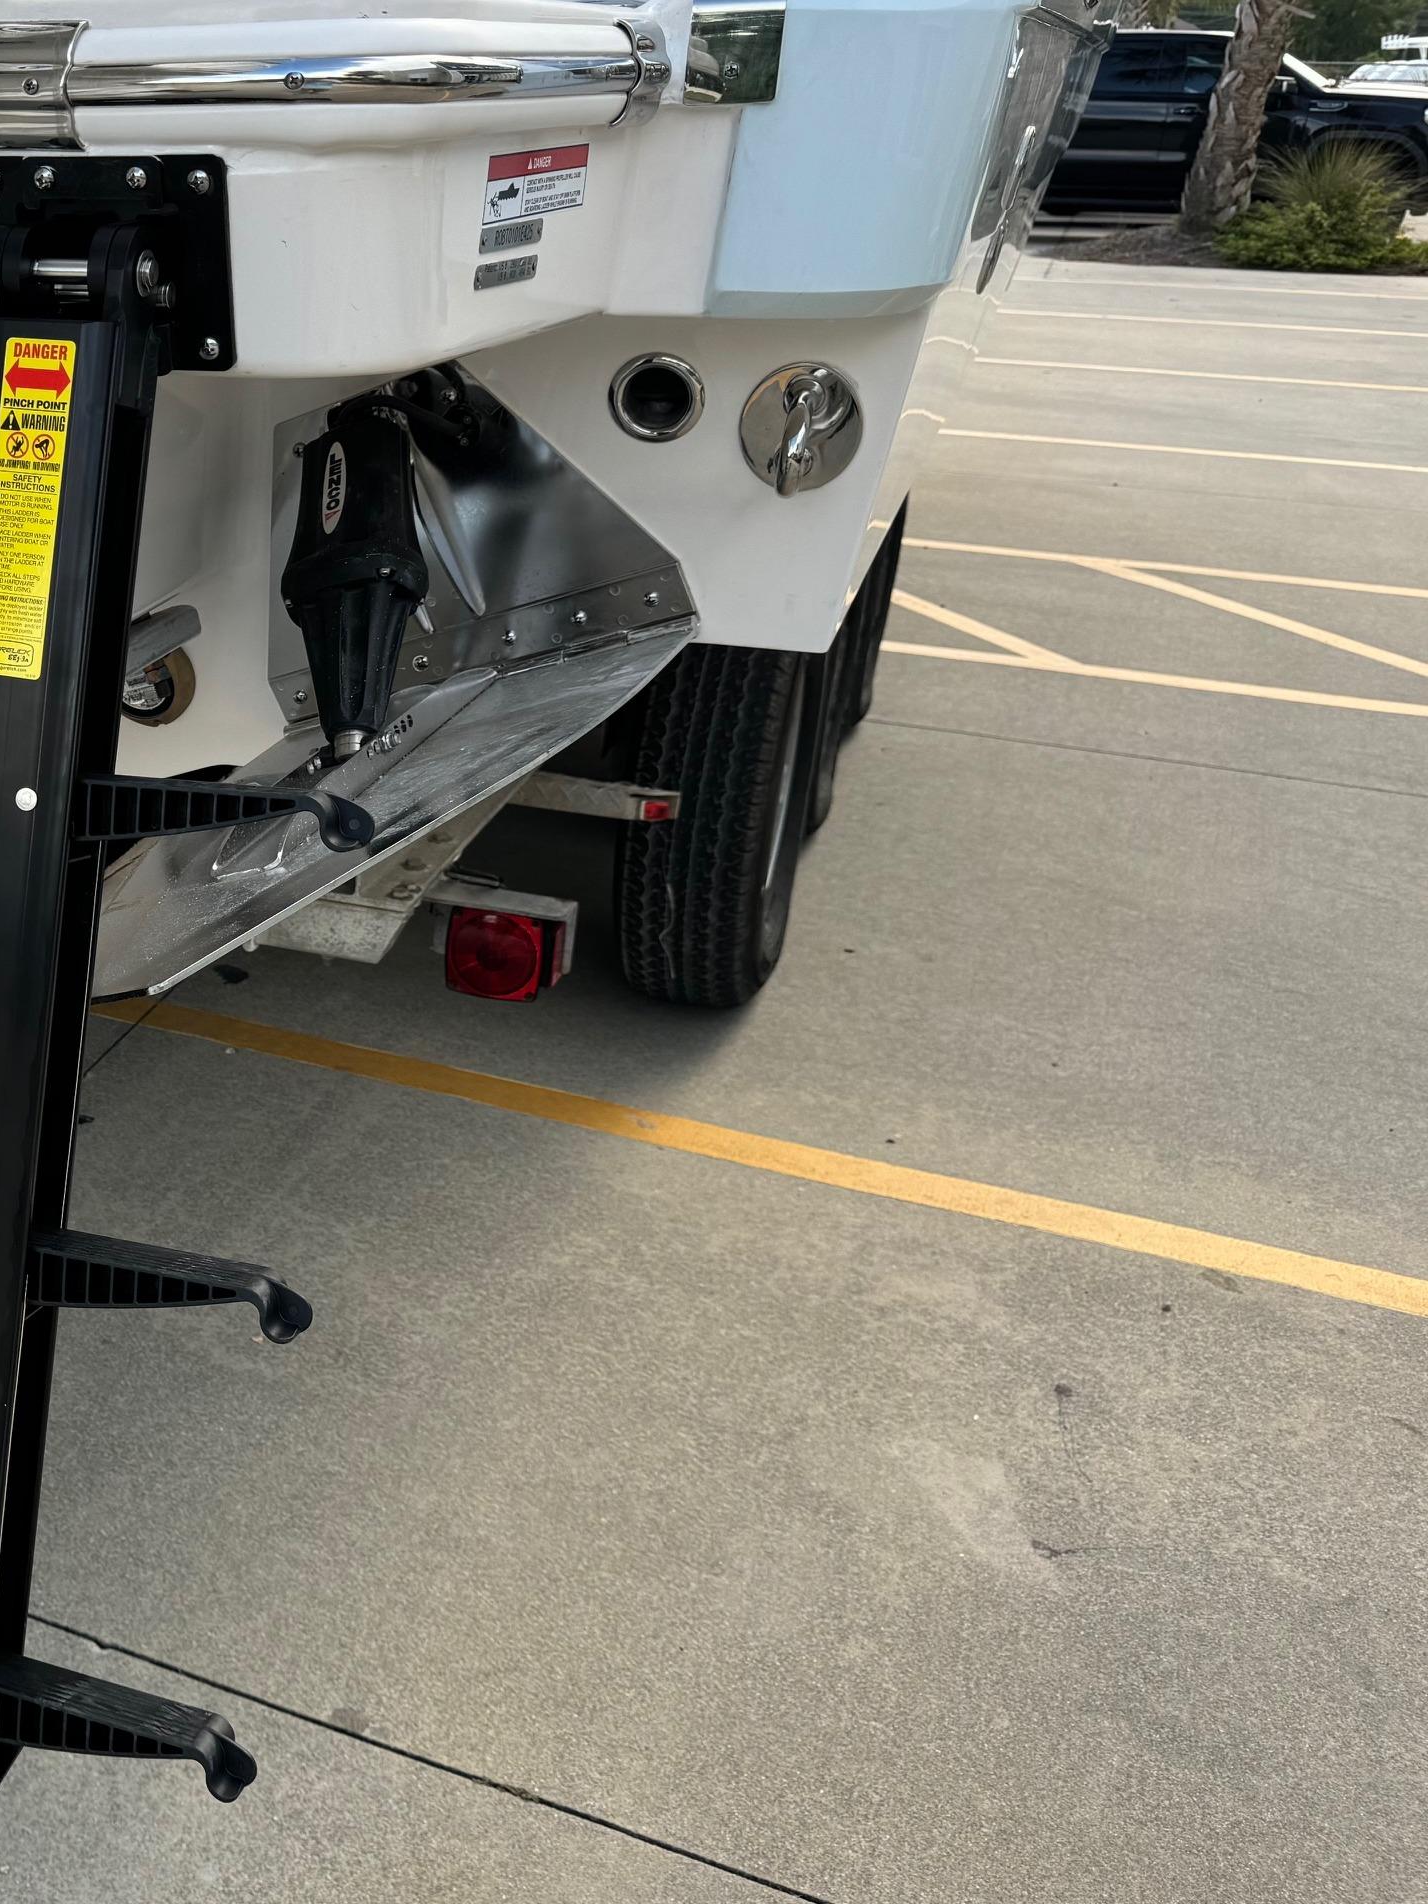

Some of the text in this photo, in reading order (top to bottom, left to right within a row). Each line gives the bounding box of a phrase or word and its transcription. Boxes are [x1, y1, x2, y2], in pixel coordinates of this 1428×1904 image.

[533, 156, 551, 168] DANGER
[13, 343, 68, 360] DANGER
[4, 398, 67, 410] PINCH POINT
[21, 414, 66, 431] WARNING
[33, 462, 40, 470] NO
[13, 474, 42, 483] SAFETY
[326, 453, 342, 511] LENCO
[12, 530, 33, 538] LADDER
[5, 578, 35, 587] HARDWARE
